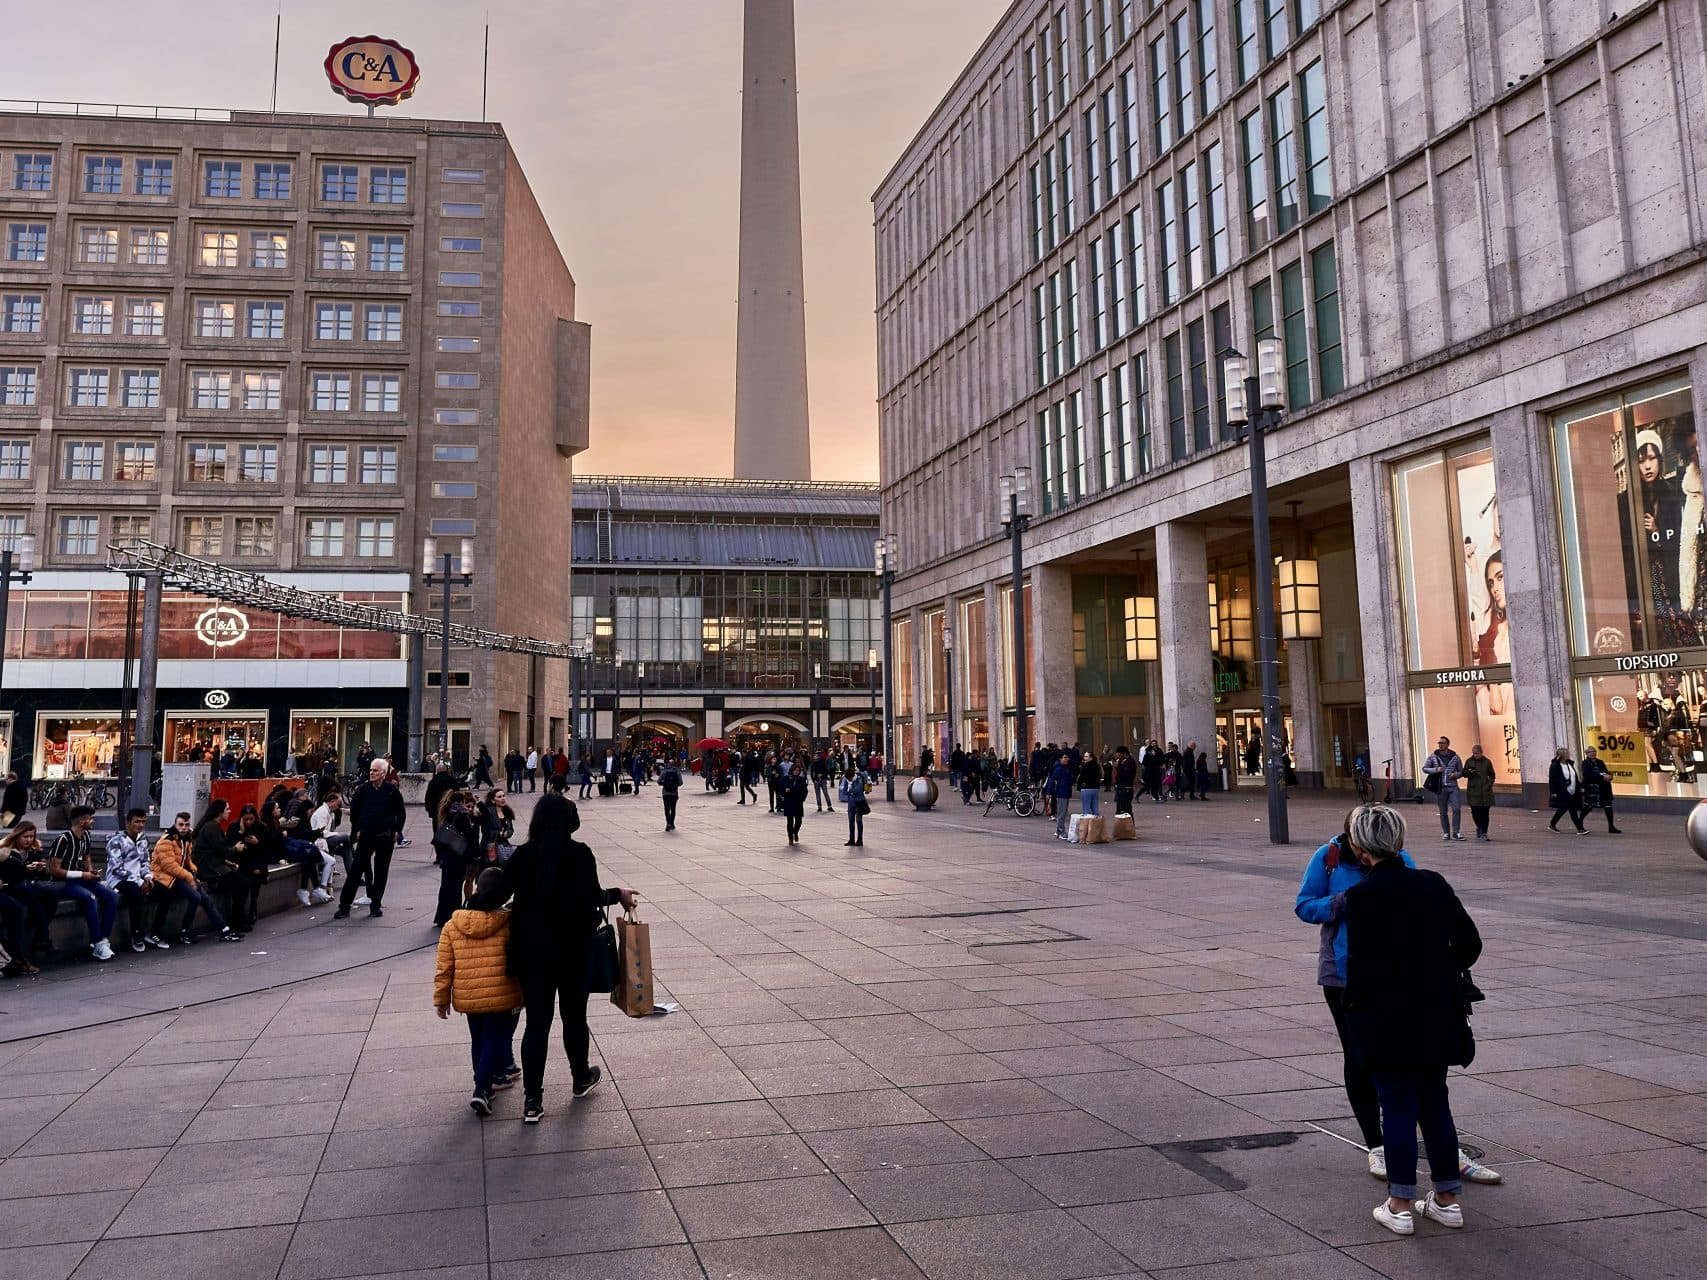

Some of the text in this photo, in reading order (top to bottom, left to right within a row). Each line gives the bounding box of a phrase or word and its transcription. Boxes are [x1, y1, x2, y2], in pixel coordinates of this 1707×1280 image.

[342, 51, 403, 83] C&A
[205, 617, 239, 636] C&A
[1614, 653, 1678, 671] TOPSHOP
[1215, 671, 1240, 693] LERIA
[1436, 669, 1485, 684] SEPHORA
[1598, 735, 1635, 751] 30%
